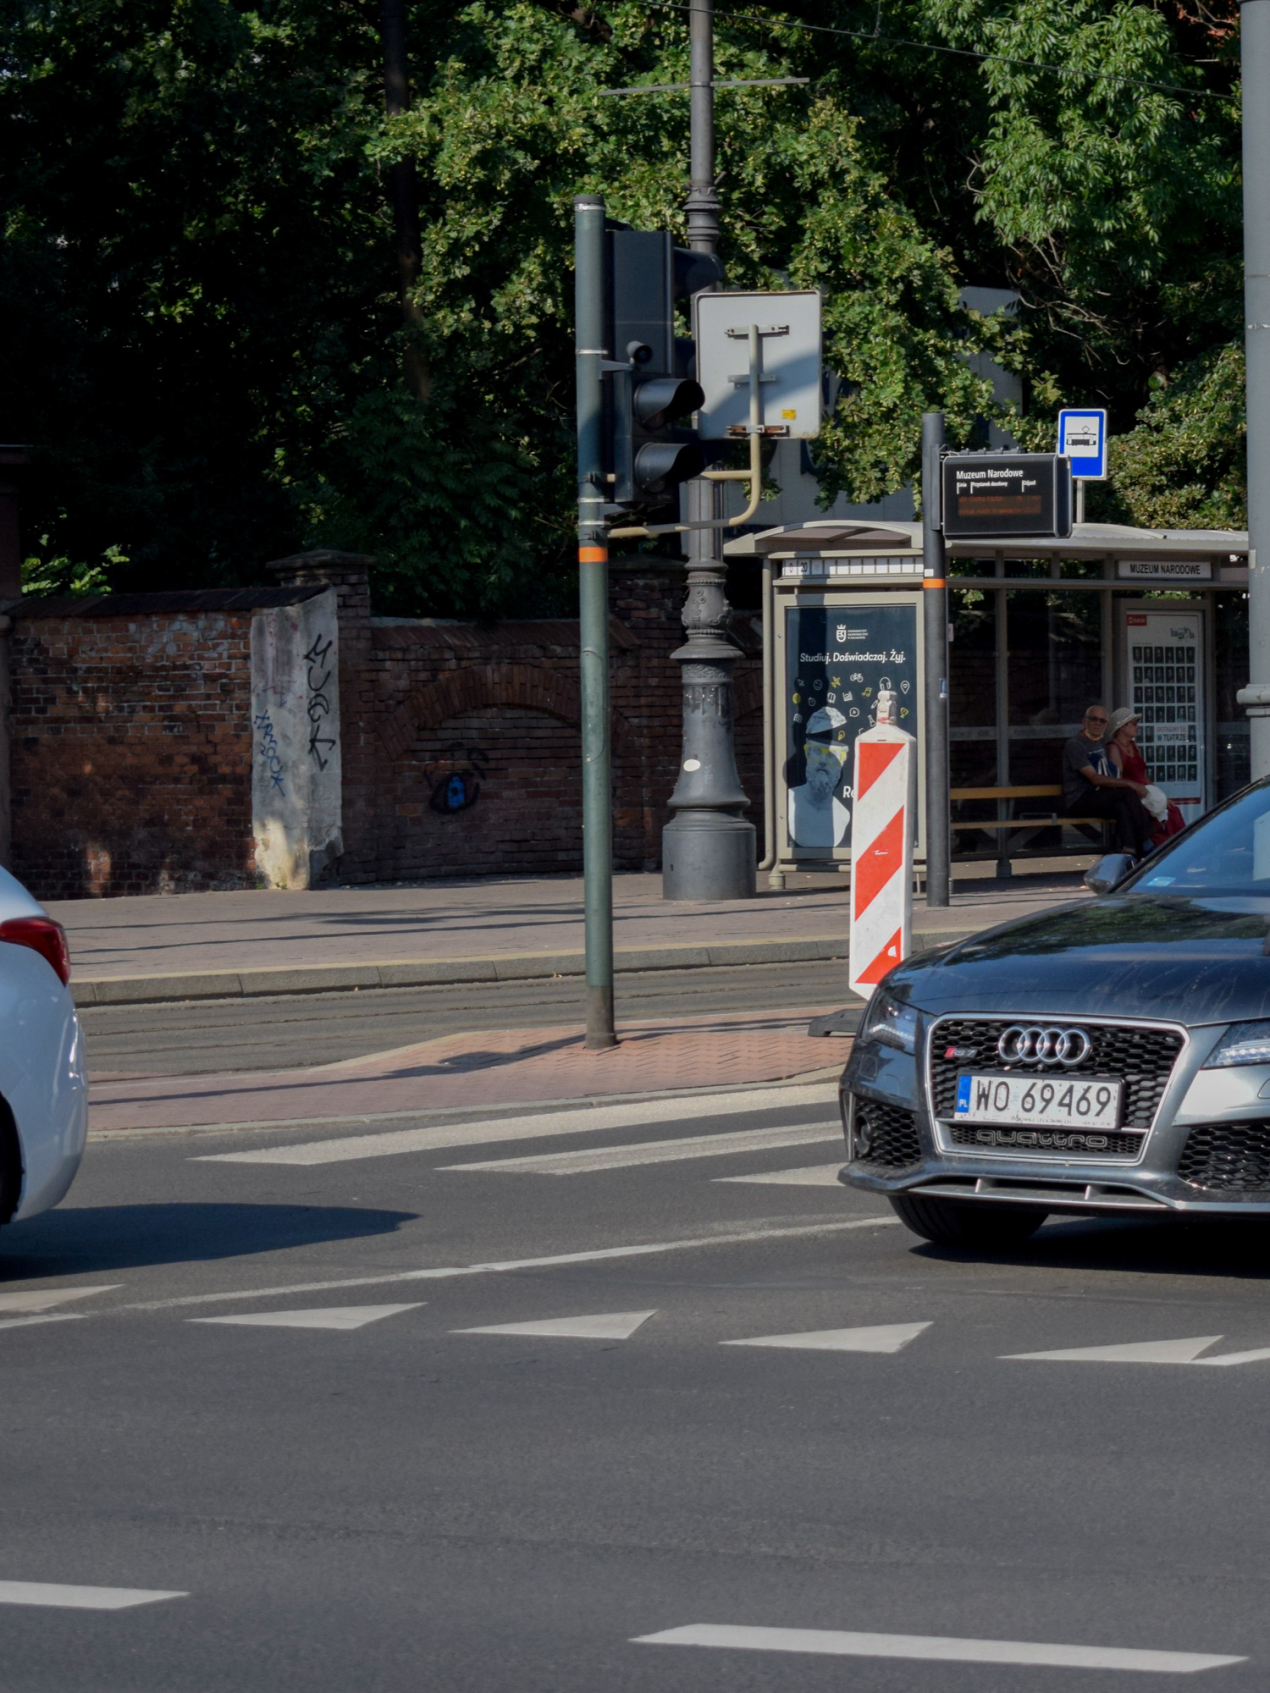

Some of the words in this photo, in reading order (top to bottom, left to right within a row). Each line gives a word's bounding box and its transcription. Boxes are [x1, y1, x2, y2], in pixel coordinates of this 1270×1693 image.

[956, 470, 986, 479] Muzeum
[987, 468, 1024, 478] Narodowe
[800, 561, 808, 573] 20
[1130, 564, 1159, 574] MUZEUM
[1161, 565, 1200, 575] NARODOWE
[800, 652, 831, 665] Studiuj.
[832, 651, 888, 664] Doświadczaj.
[889, 648, 906, 664] Żyj.
[1163, 734, 1186, 742] TEATRZE
[958, 1098, 969, 1108] PL
[1021, 1082, 1111, 1117] 69469
[976, 1128, 1108, 1147] quattro
